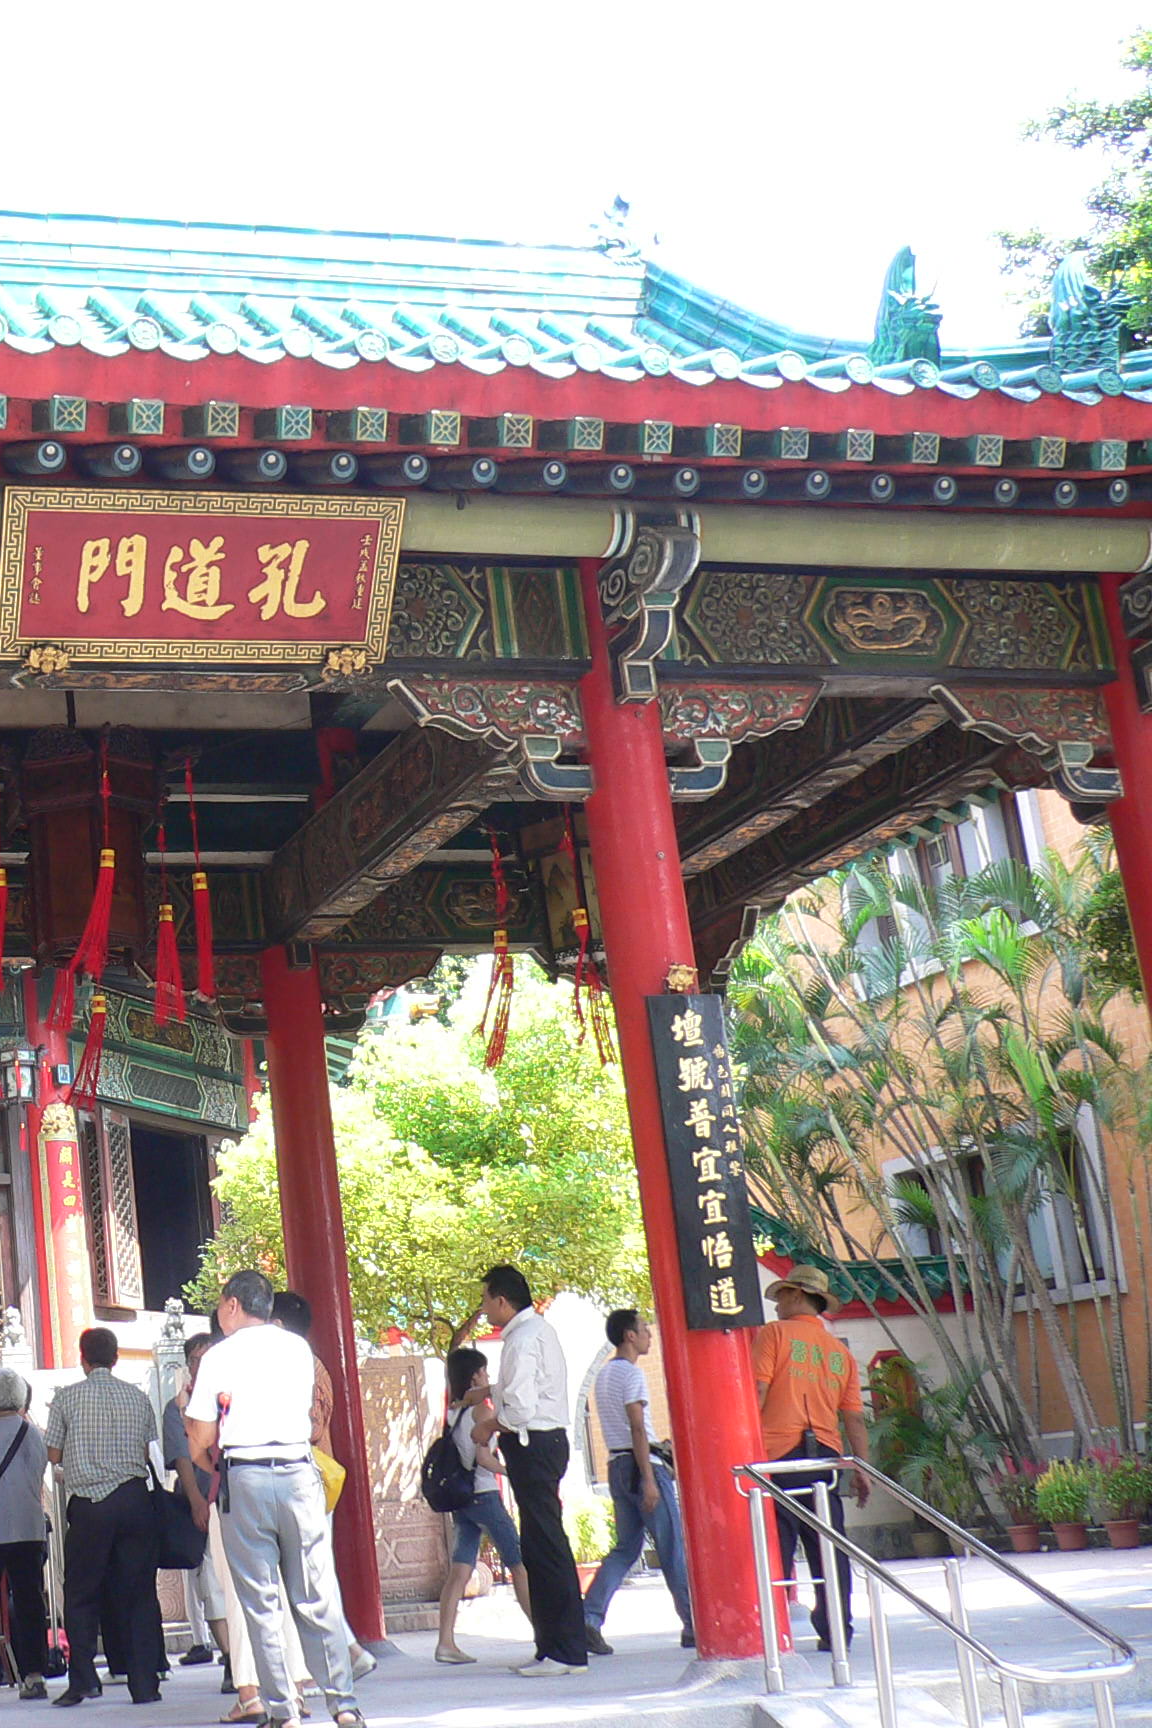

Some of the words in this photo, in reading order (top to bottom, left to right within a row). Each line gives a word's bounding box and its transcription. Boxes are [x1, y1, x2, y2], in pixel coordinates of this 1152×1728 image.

[670, 1009, 744, 1316] 壇號普宜宜悟道
